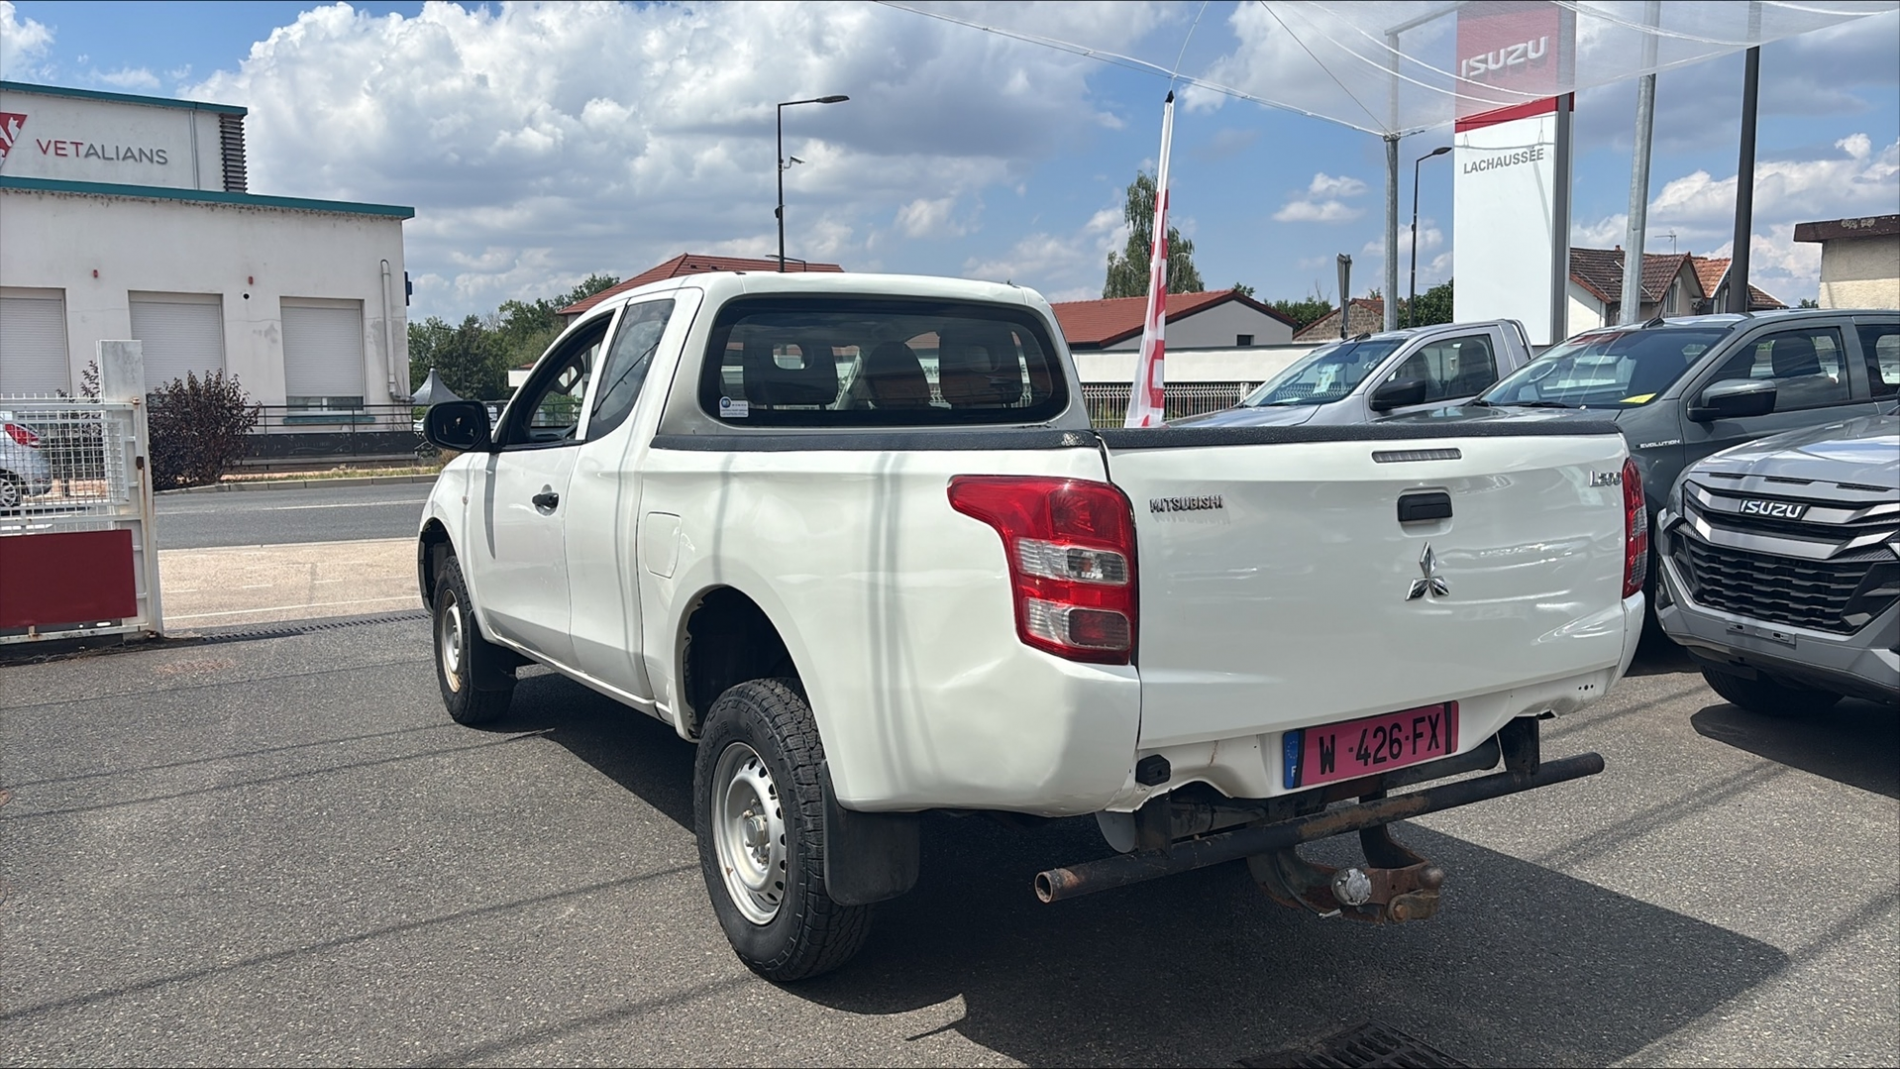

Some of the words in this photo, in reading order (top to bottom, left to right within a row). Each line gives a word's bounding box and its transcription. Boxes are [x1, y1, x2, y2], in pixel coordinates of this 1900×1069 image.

[1461, 36, 1549, 78] ISUZU
[36, 138, 168, 165] VETALIANS
[1463, 147, 1544, 174] LACHAUSSÉE
[1640, 439, 1680, 449] EVOLUTION
[1149, 495, 1223, 513] MITSUBISHI
[1740, 500, 1802, 518] ISUZU
